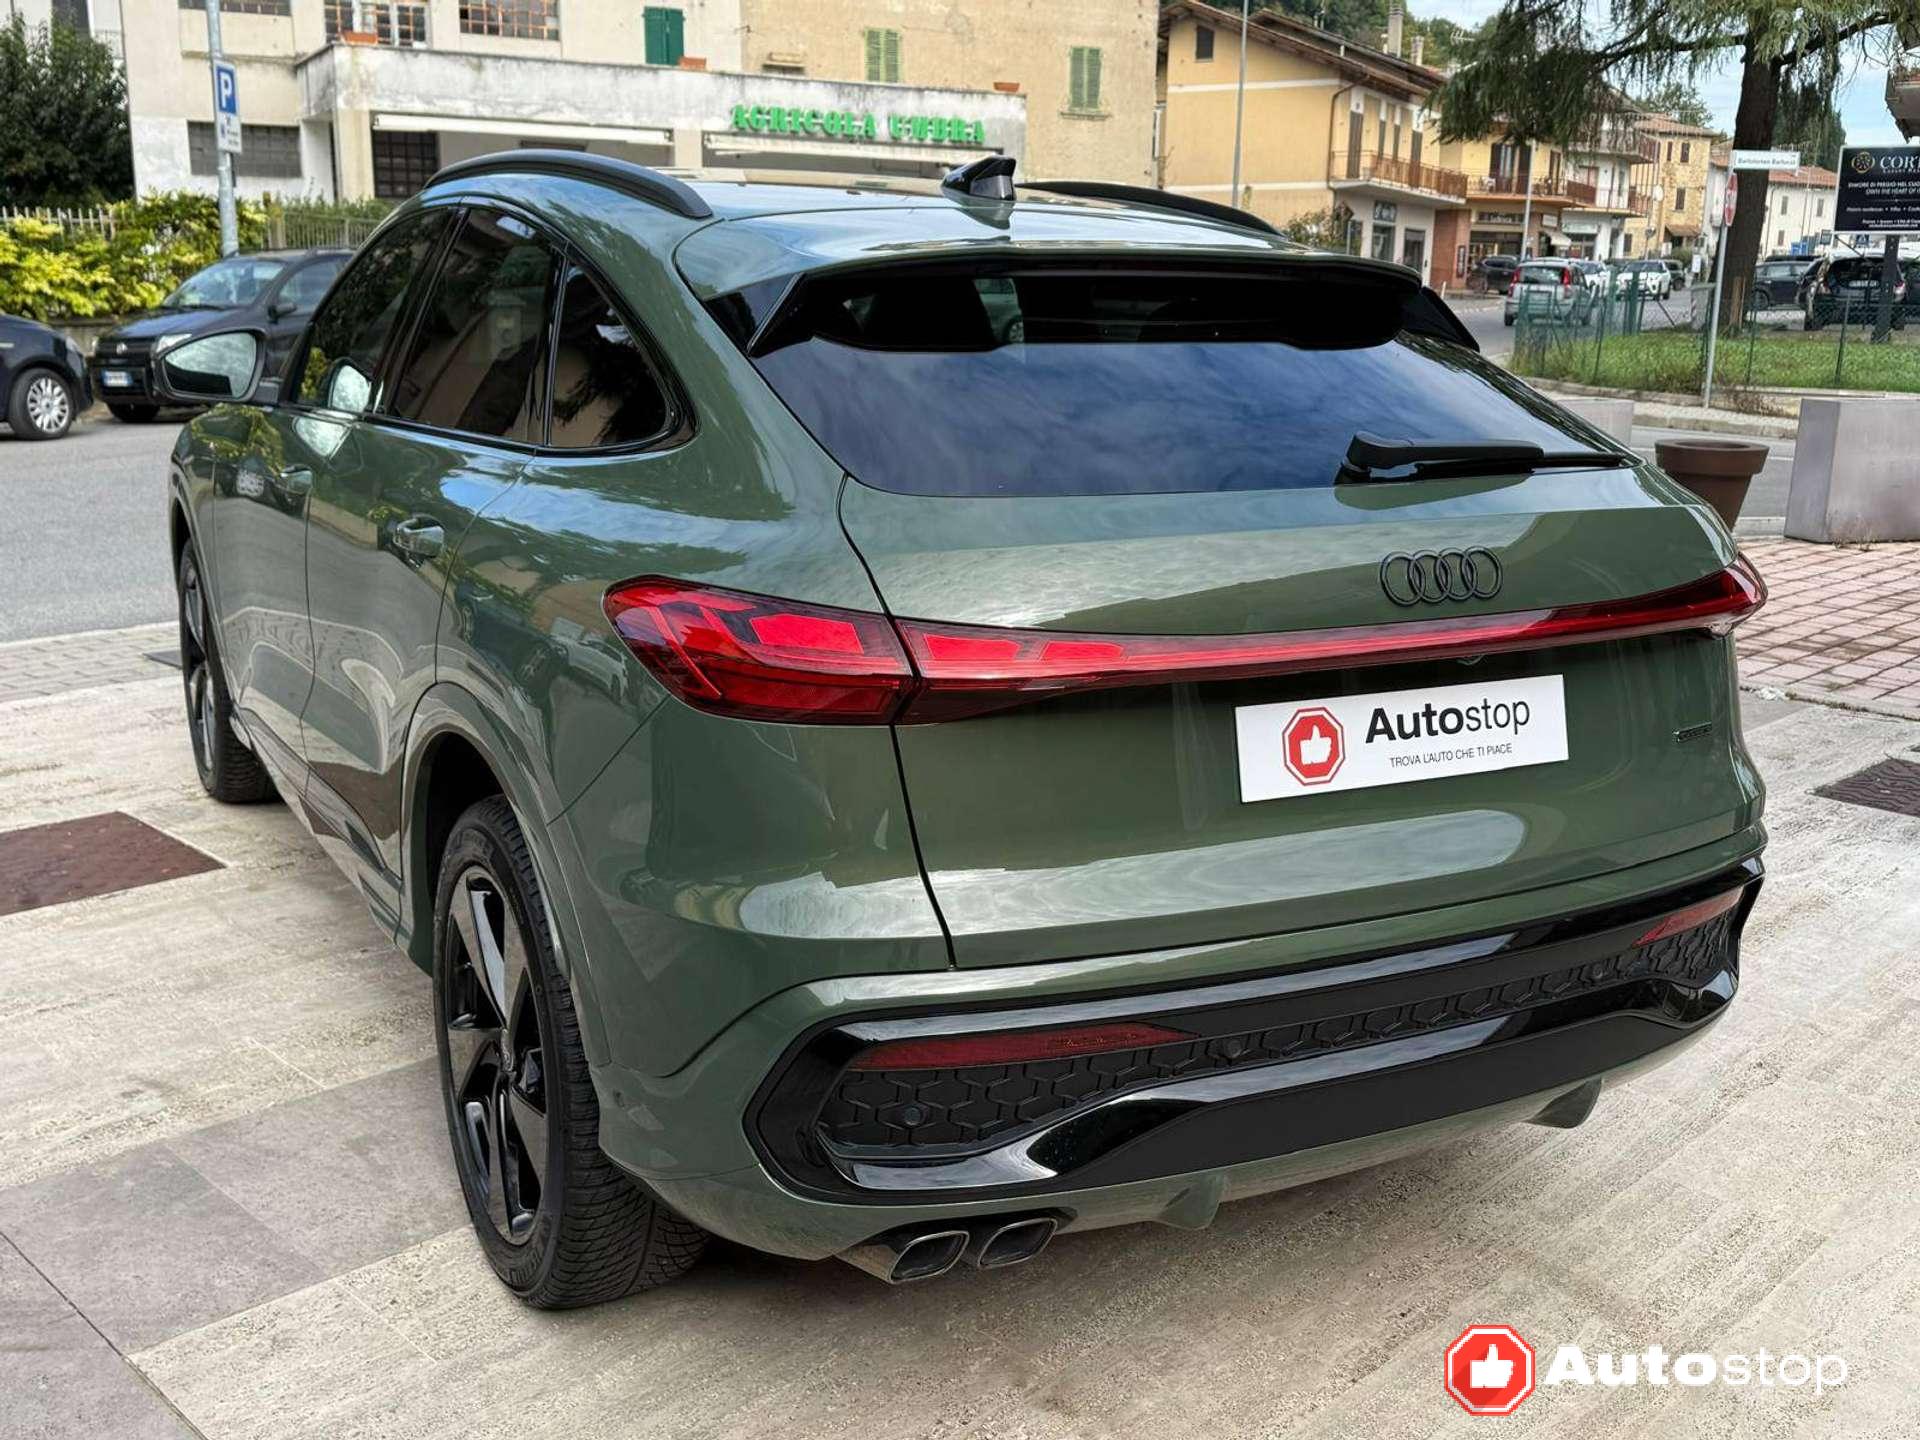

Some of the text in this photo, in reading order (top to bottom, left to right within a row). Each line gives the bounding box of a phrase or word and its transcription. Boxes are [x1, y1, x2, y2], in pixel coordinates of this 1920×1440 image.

[220, 72, 232, 109] P
[731, 104, 985, 144] AGRICOLA UMBRA
[1365, 697, 1530, 743] Autostop
[1390, 742, 1513, 768] TROVA L'AUTO CHE TI PIACE
